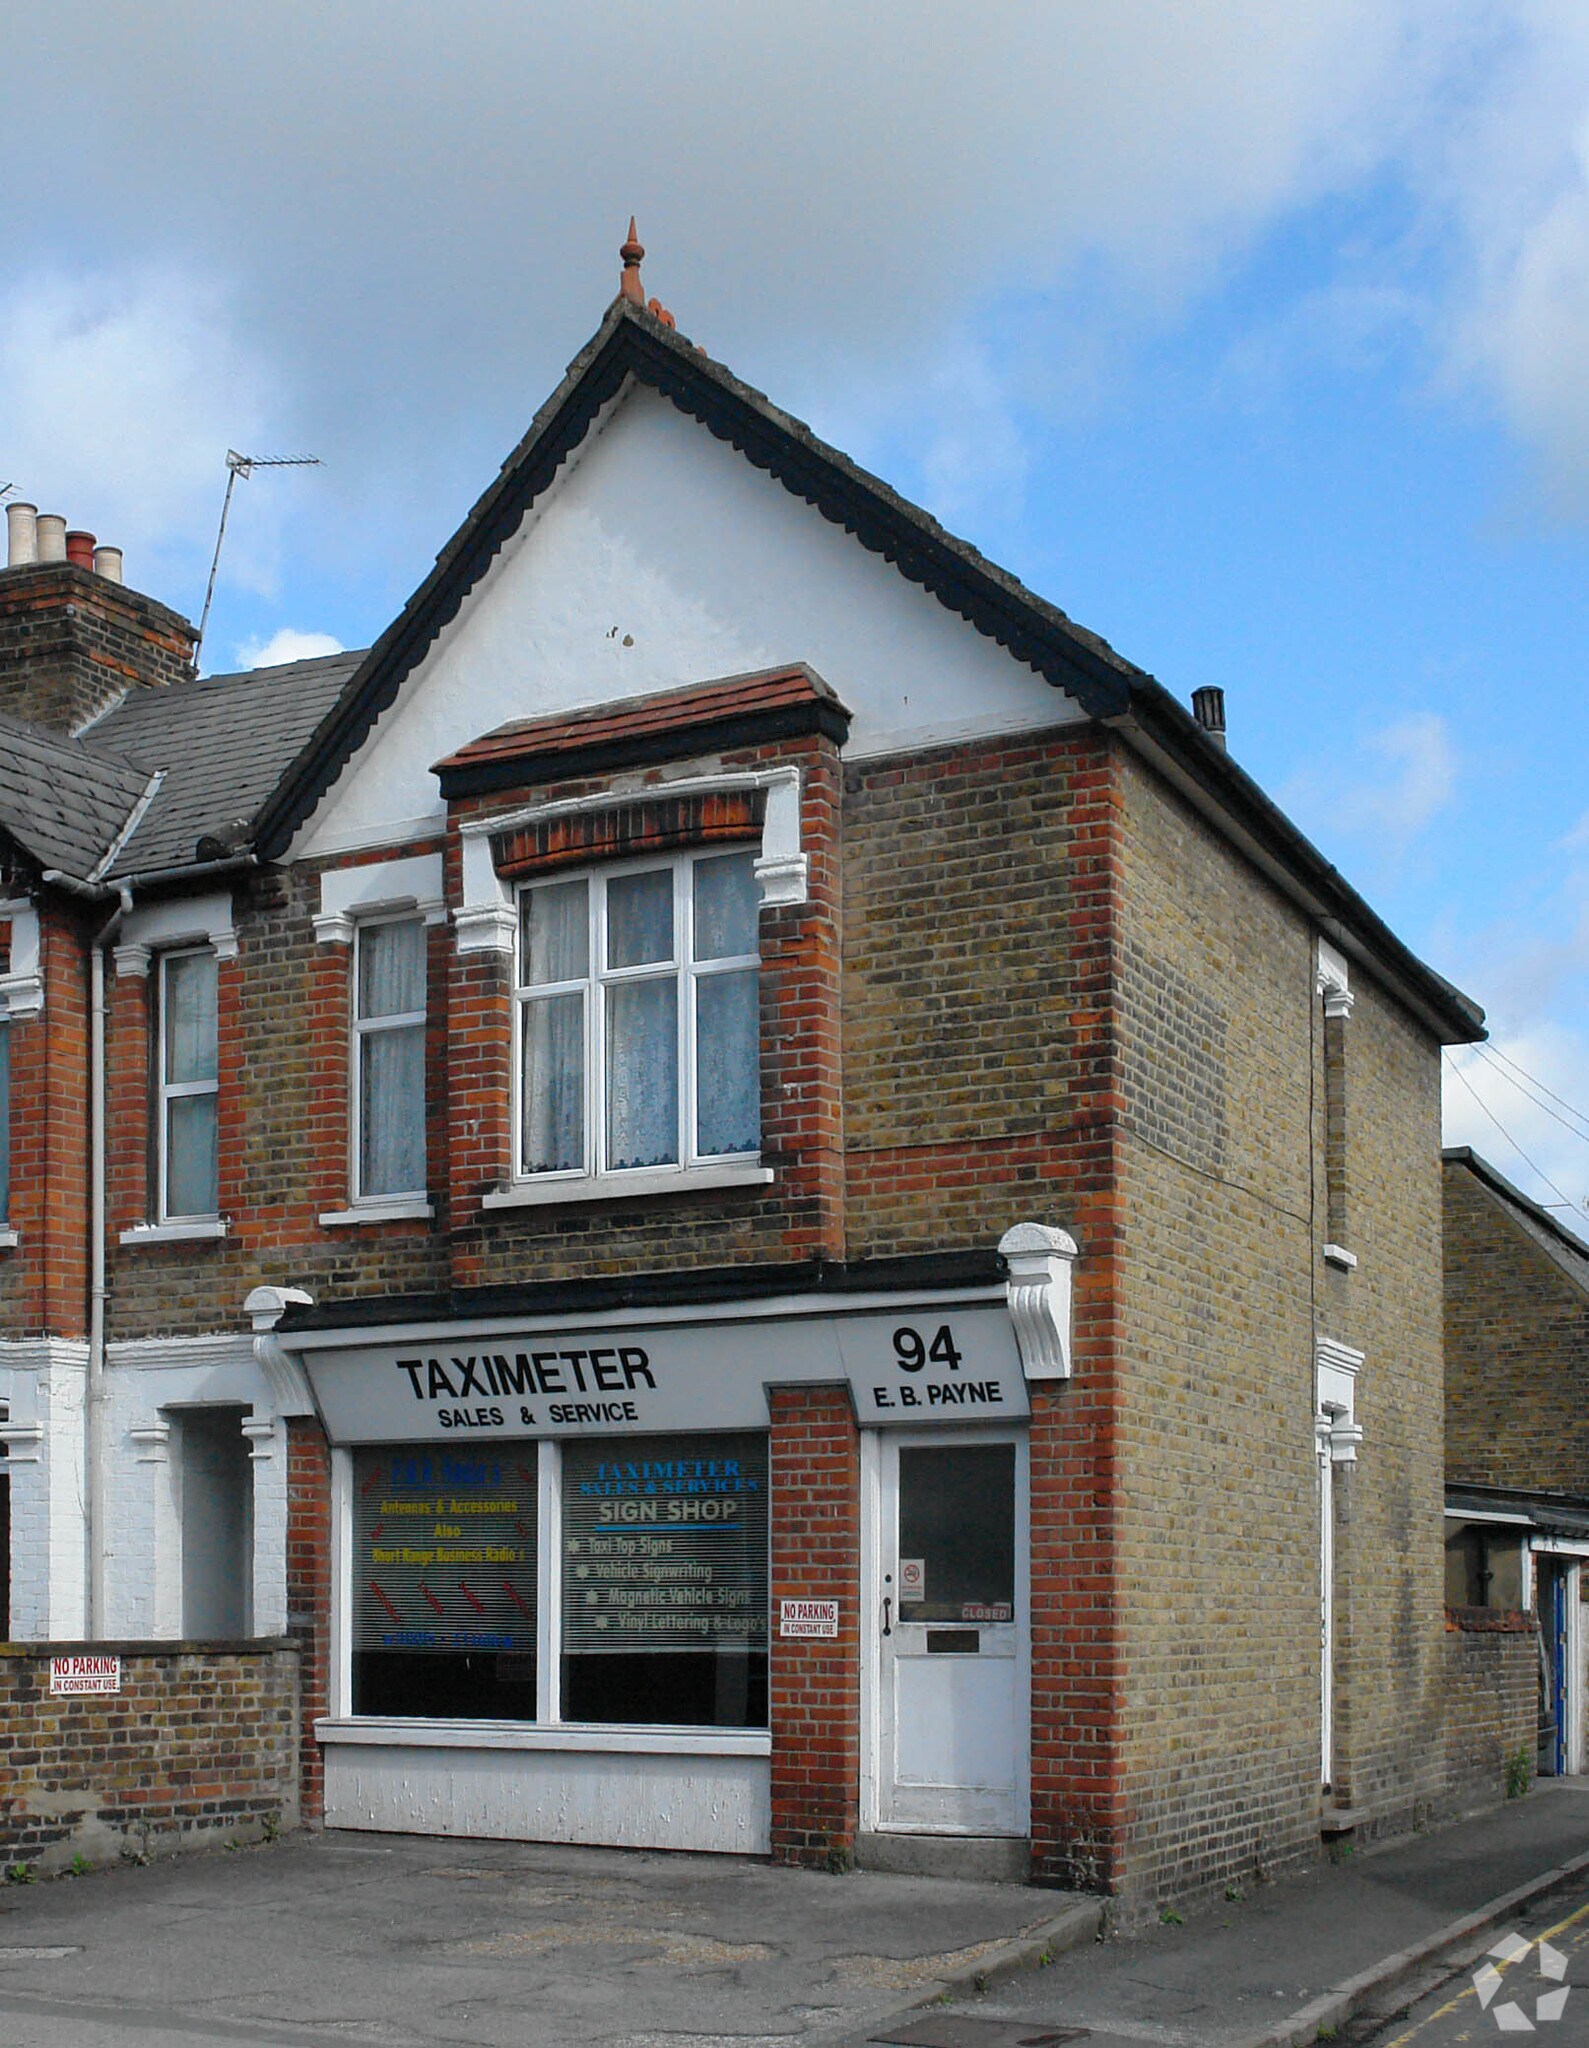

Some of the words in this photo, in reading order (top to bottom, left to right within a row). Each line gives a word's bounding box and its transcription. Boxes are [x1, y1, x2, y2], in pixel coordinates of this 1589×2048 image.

[892, 1325, 962, 1372] 94
[395, 1347, 657, 1400] TAXIMETER
[873, 1387, 895, 1407] E.
[900, 1386, 922, 1406] B.
[927, 1382, 1003, 1405] PAYNE
[438, 1407, 504, 1428] SALES
[520, 1406, 536, 1425] &
[549, 1402, 639, 1423] SERVICE
[596, 1459, 740, 1480] TAXIMETER
[578, 1481, 638, 1495] SALES
[644, 1480, 657, 1494] &
[662, 1478, 759, 1493] SERVICES
[450, 1499, 518, 1513] Accessories
[600, 1501, 656, 1522] SIGN
[668, 1500, 737, 1521] SHOP
[434, 1523, 462, 1537] Also
[436, 1547, 482, 1562] Business
[589, 1537, 612, 1553] Taxi
[640, 1537, 672, 1557] Signs
[597, 1562, 637, 1578] Vehicle
[644, 1561, 712, 1582] Signwriting
[609, 1588, 664, 1607] Magnetic
[670, 1588, 712, 1604] Vehicle
[718, 1588, 750, 1607] Signs
[784, 1603, 796, 1619] NO
[798, 1603, 834, 1620] PARKING
[962, 1607, 1006, 1620] CLOSED
[618, 1612, 646, 1631] Vinyl
[651, 1613, 709, 1634] Lettering
[784, 1624, 789, 1632] IN
[791, 1624, 820, 1633] CONSTANT
[822, 1625, 833, 1634] USE
[54, 1658, 69, 1675] NO
[73, 1657, 116, 1674] PARKING
[54, 1681, 61, 1691] IN
[64, 1680, 101, 1691] CONSTANT
[103, 1679, 116, 1689] USE
